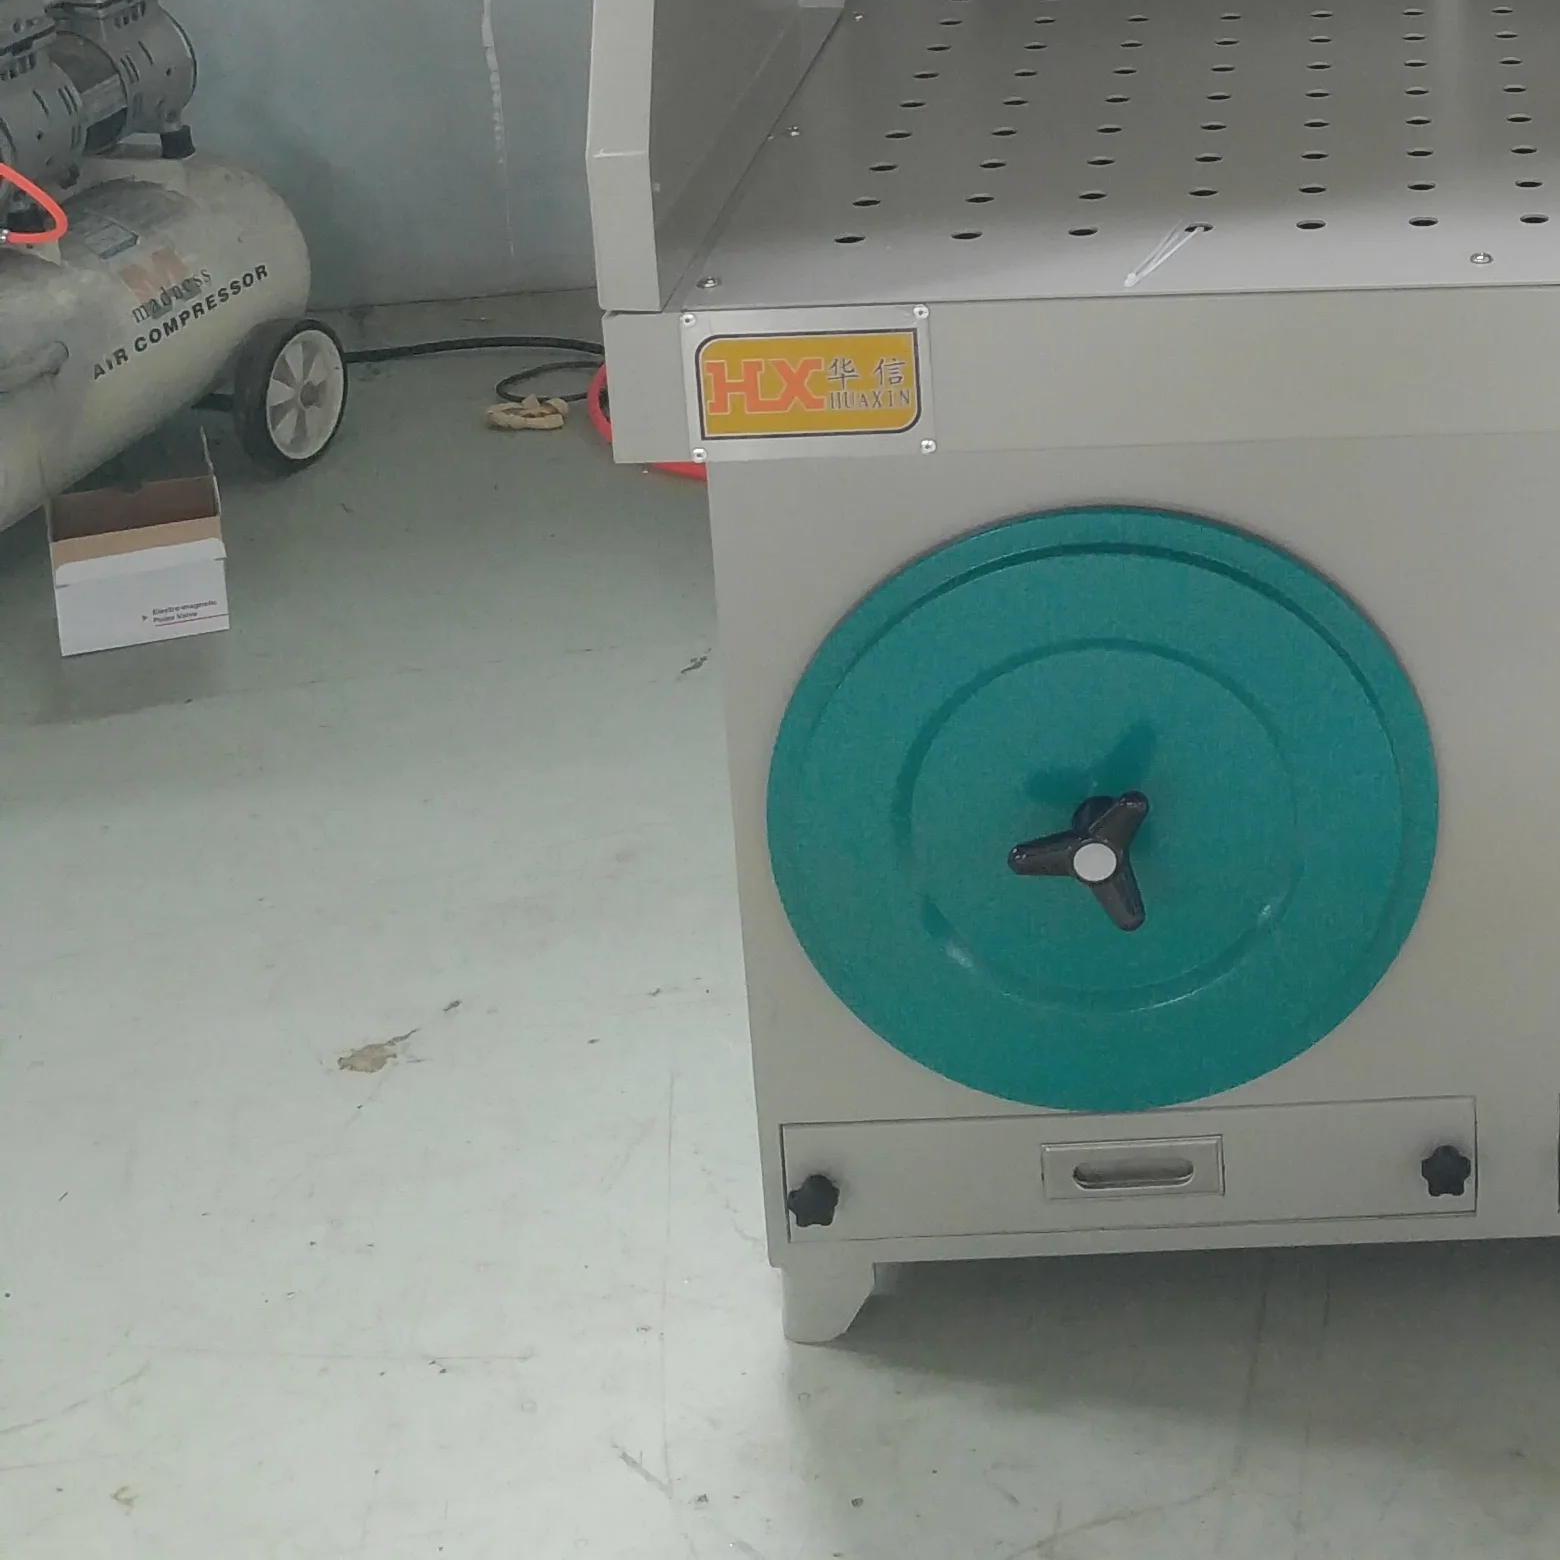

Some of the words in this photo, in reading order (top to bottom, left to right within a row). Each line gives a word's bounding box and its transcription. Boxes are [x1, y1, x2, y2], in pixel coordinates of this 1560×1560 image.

[92, 346, 129, 381] AIR
[134, 264, 269, 352] COMPRESSOR
[828, 389, 910, 411] HUAXIN
